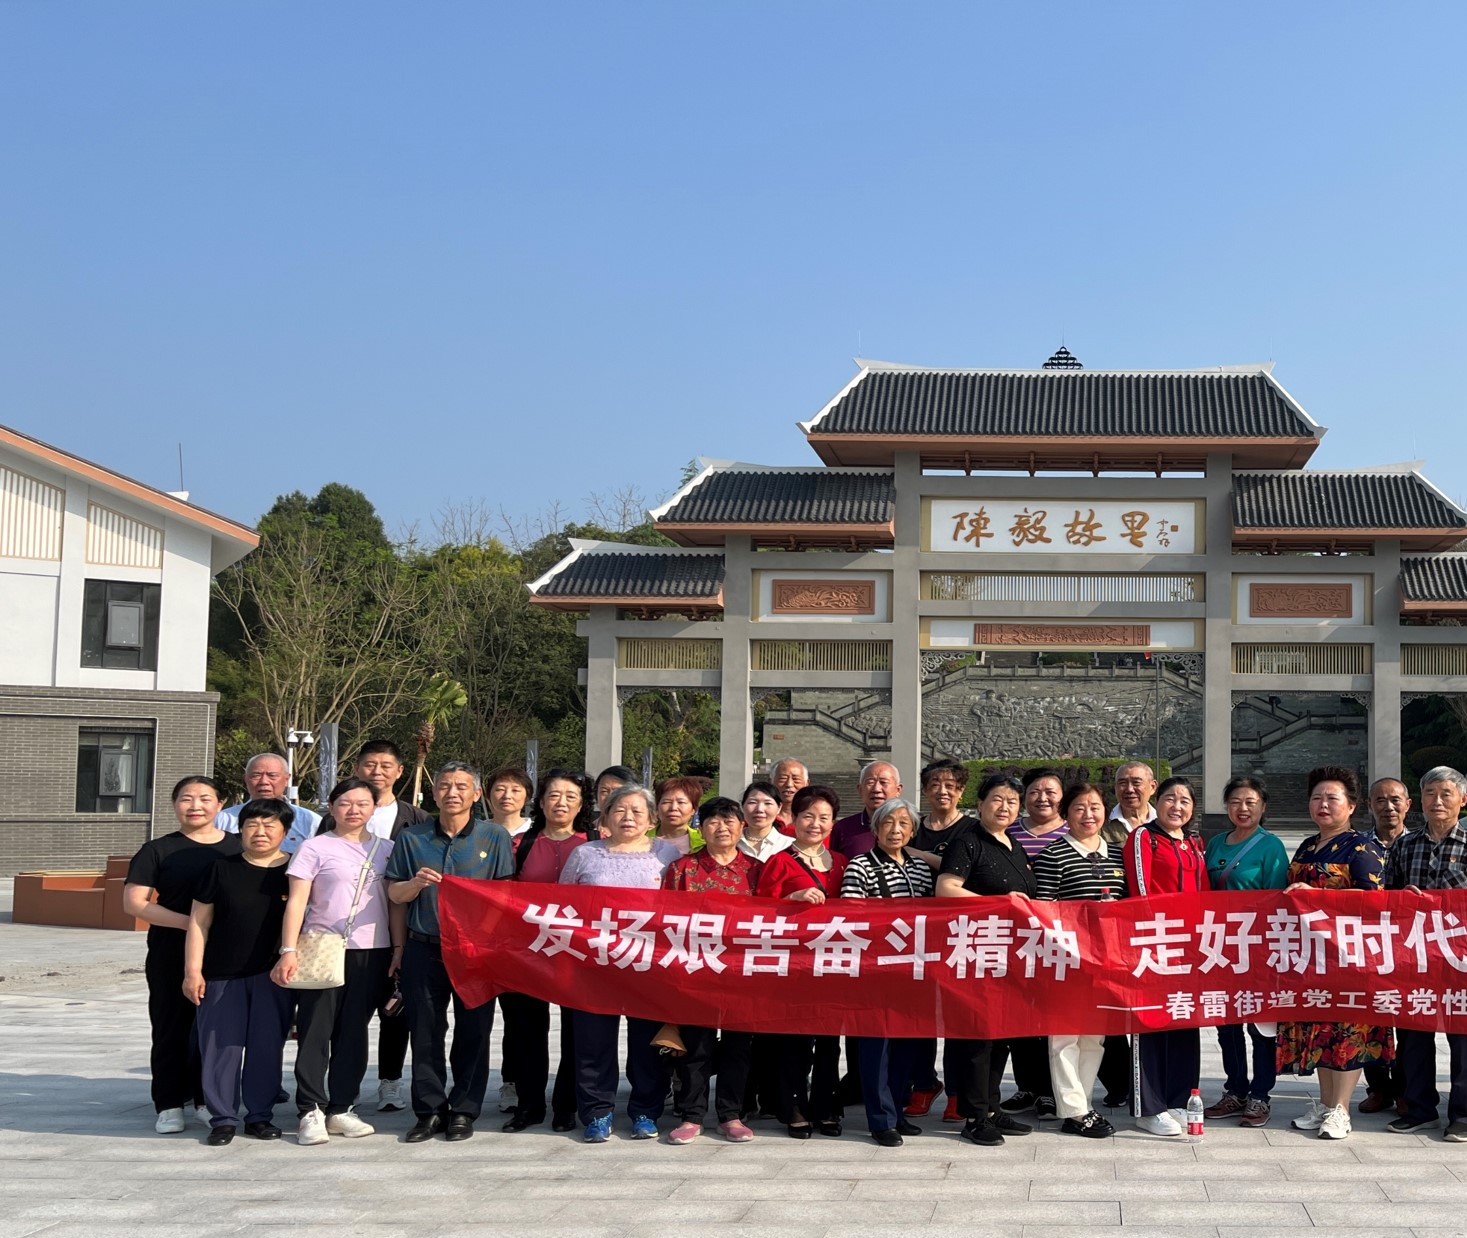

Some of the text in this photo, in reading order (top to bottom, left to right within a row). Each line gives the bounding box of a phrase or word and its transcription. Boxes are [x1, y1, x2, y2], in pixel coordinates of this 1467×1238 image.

[521, 903, 1081, 981] 发扬艰苦奋斗精神
